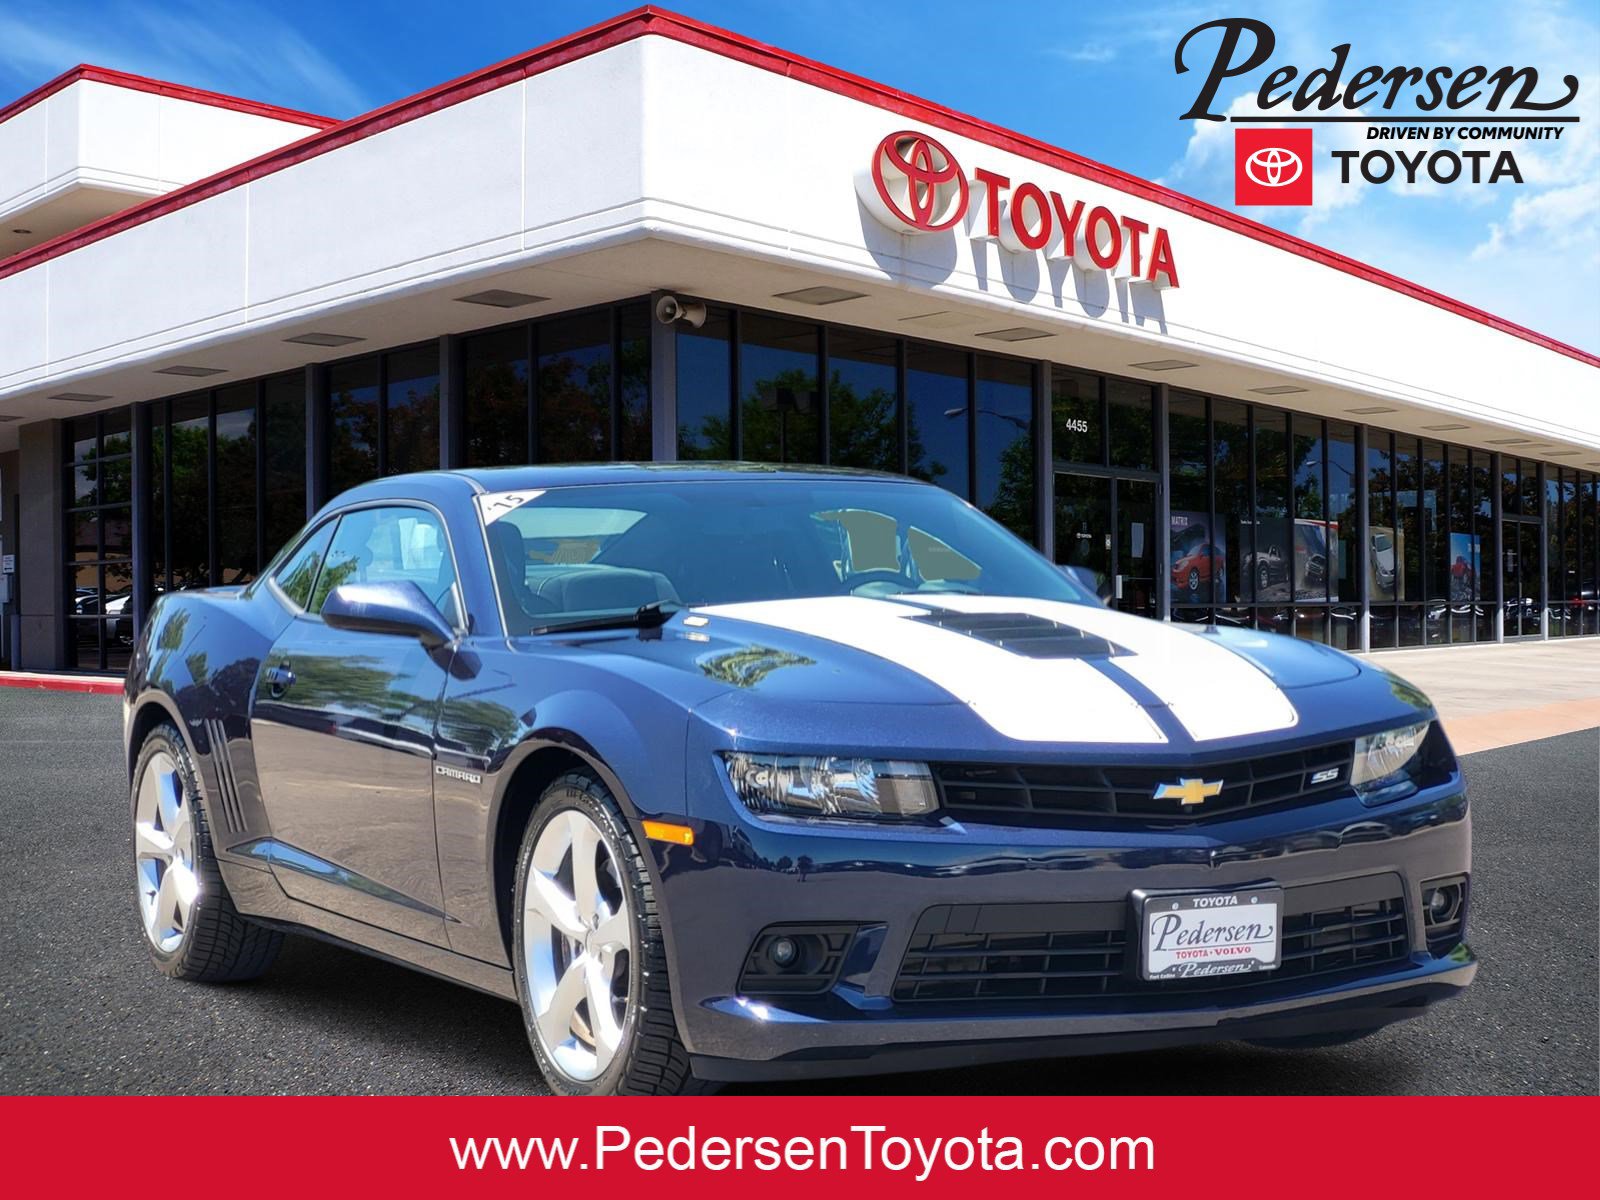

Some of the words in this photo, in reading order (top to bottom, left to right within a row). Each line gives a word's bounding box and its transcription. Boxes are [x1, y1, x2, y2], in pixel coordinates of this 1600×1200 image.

[974, 167, 1180, 289] TOYOTA
[1065, 418, 1088, 433] 4455
[1310, 767, 1339, 785] SS
[1192, 895, 1238, 908] TOYOTA
[1151, 913, 1274, 952] Pedersen
[1176, 951, 1209, 959] TOYOTA
[1215, 946, 1252, 956] VOLVO
[1178, 960, 1252, 978] Pedersen
